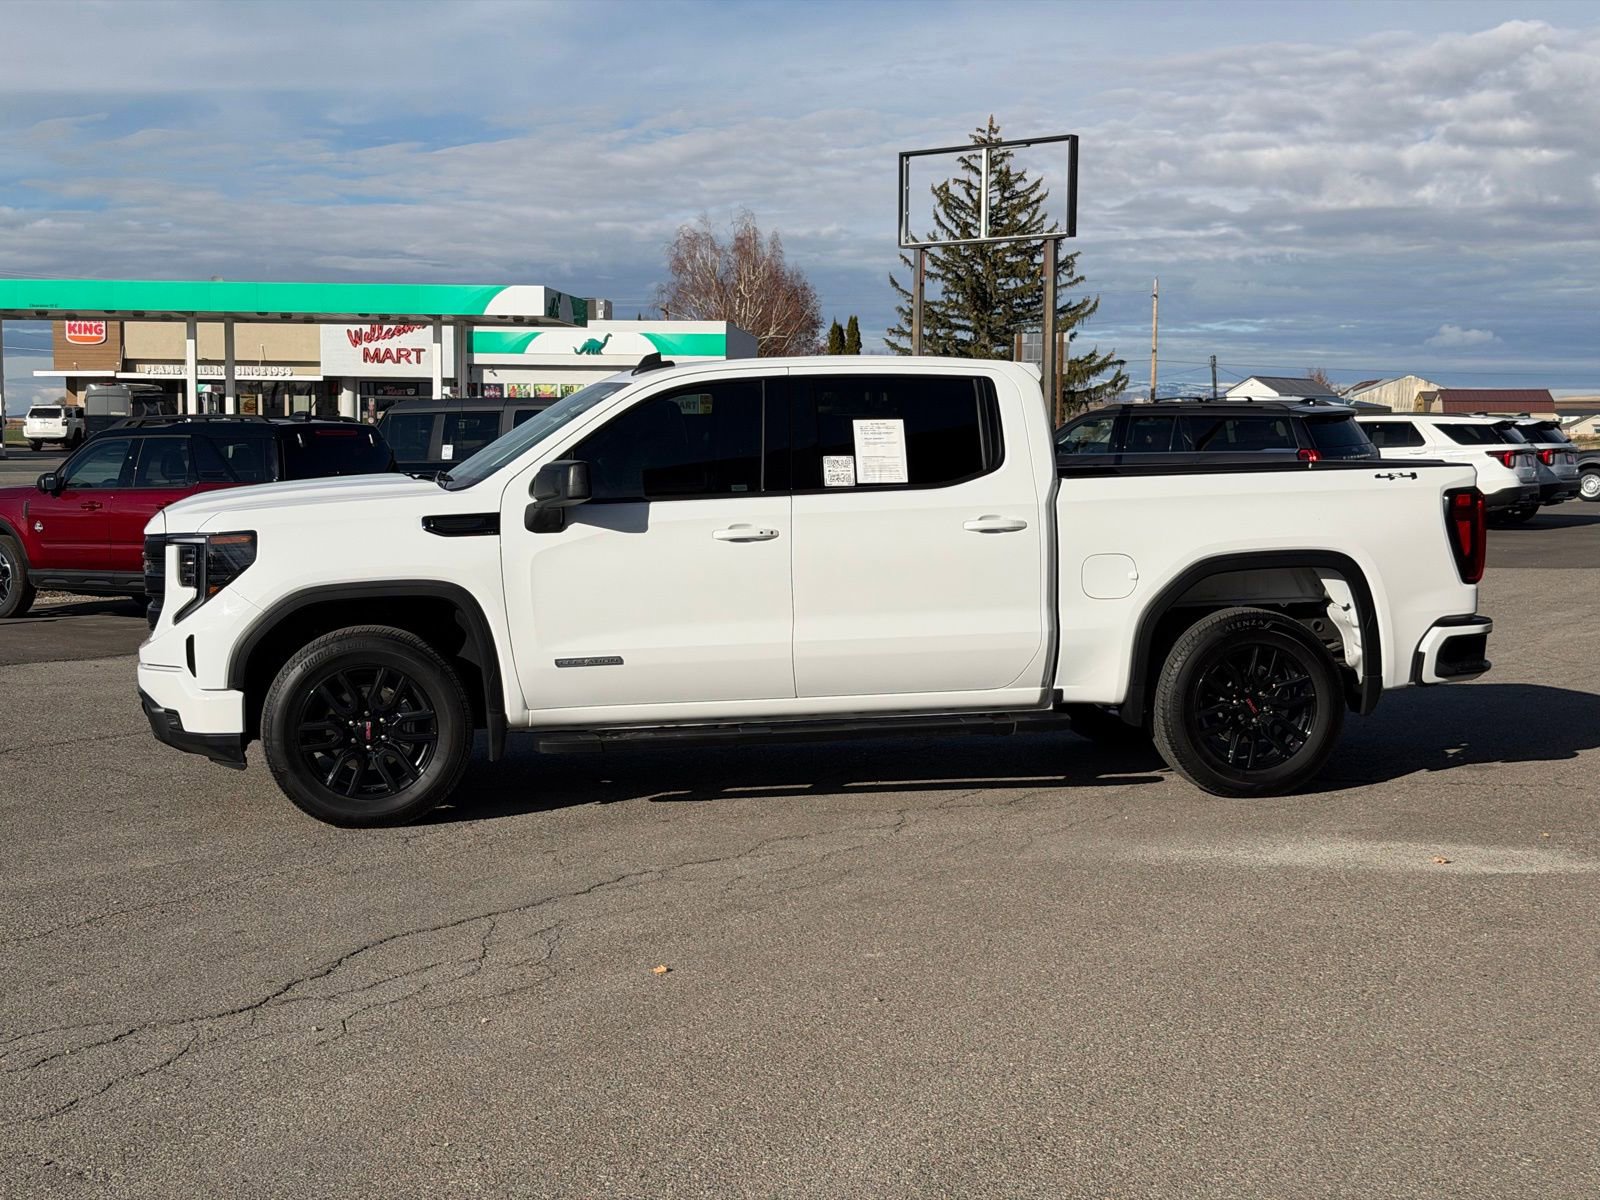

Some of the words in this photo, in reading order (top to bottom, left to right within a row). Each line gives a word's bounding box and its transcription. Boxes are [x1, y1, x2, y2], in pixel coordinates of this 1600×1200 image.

[67, 323, 104, 335] KING
[363, 347, 426, 364] MART
[145, 365, 182, 375] FLAME
[235, 366, 267, 376] SINCE
[267, 366, 293, 377] 1954
[1224, 619, 1264, 633] ALENZA
